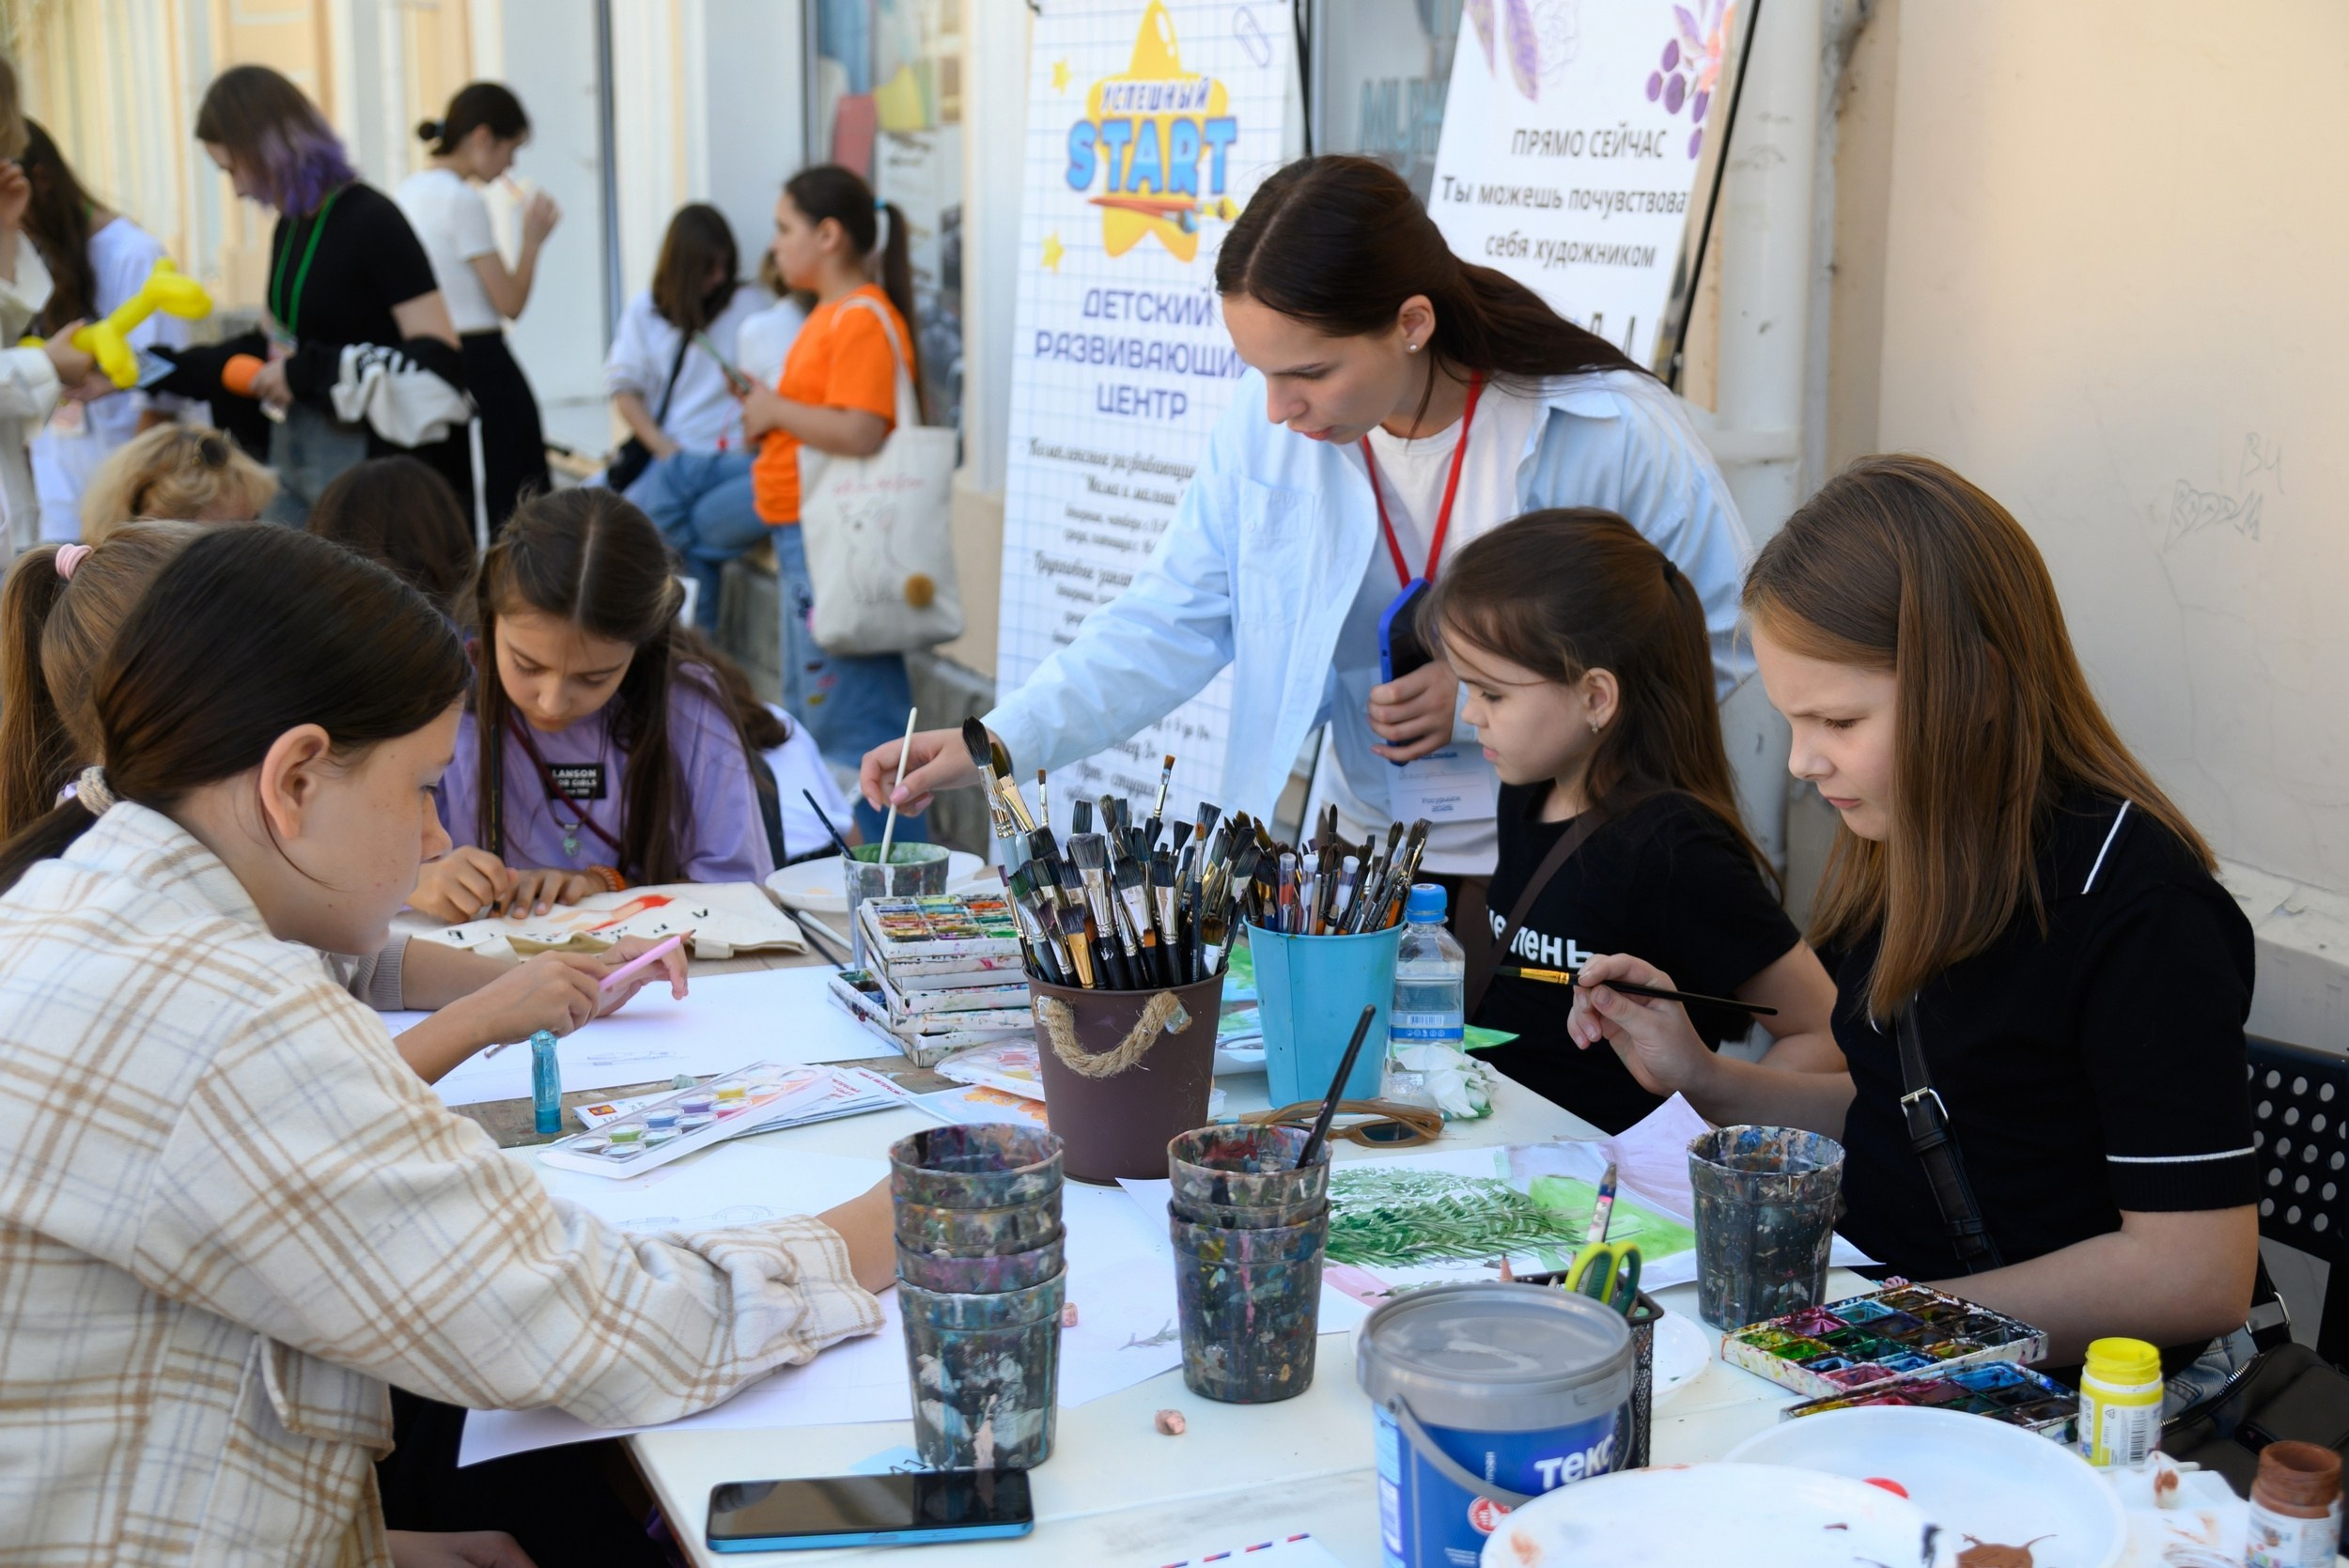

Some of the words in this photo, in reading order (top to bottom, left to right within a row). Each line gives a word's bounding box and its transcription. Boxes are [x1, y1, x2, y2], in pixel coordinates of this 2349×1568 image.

[1100, 78, 1213, 112] УСПЕШНЫЙ
[1066, 116, 1238, 196] START
[1511, 129, 1585, 158] ПРЯМО
[1589, 122, 1668, 160] СЕЙЧАС
[1441, 176, 1471, 204] Ты
[1477, 183, 1563, 210] можешь
[1568, 187, 1688, 220] почувствова
[1486, 231, 1528, 258] себя
[1533, 239, 1657, 269] художником
[1082, 287, 1213, 326] ДЕТСКИЙ
[1096, 383, 1188, 419] ЦЕНТР
[552, 769, 597, 778] LANSON
